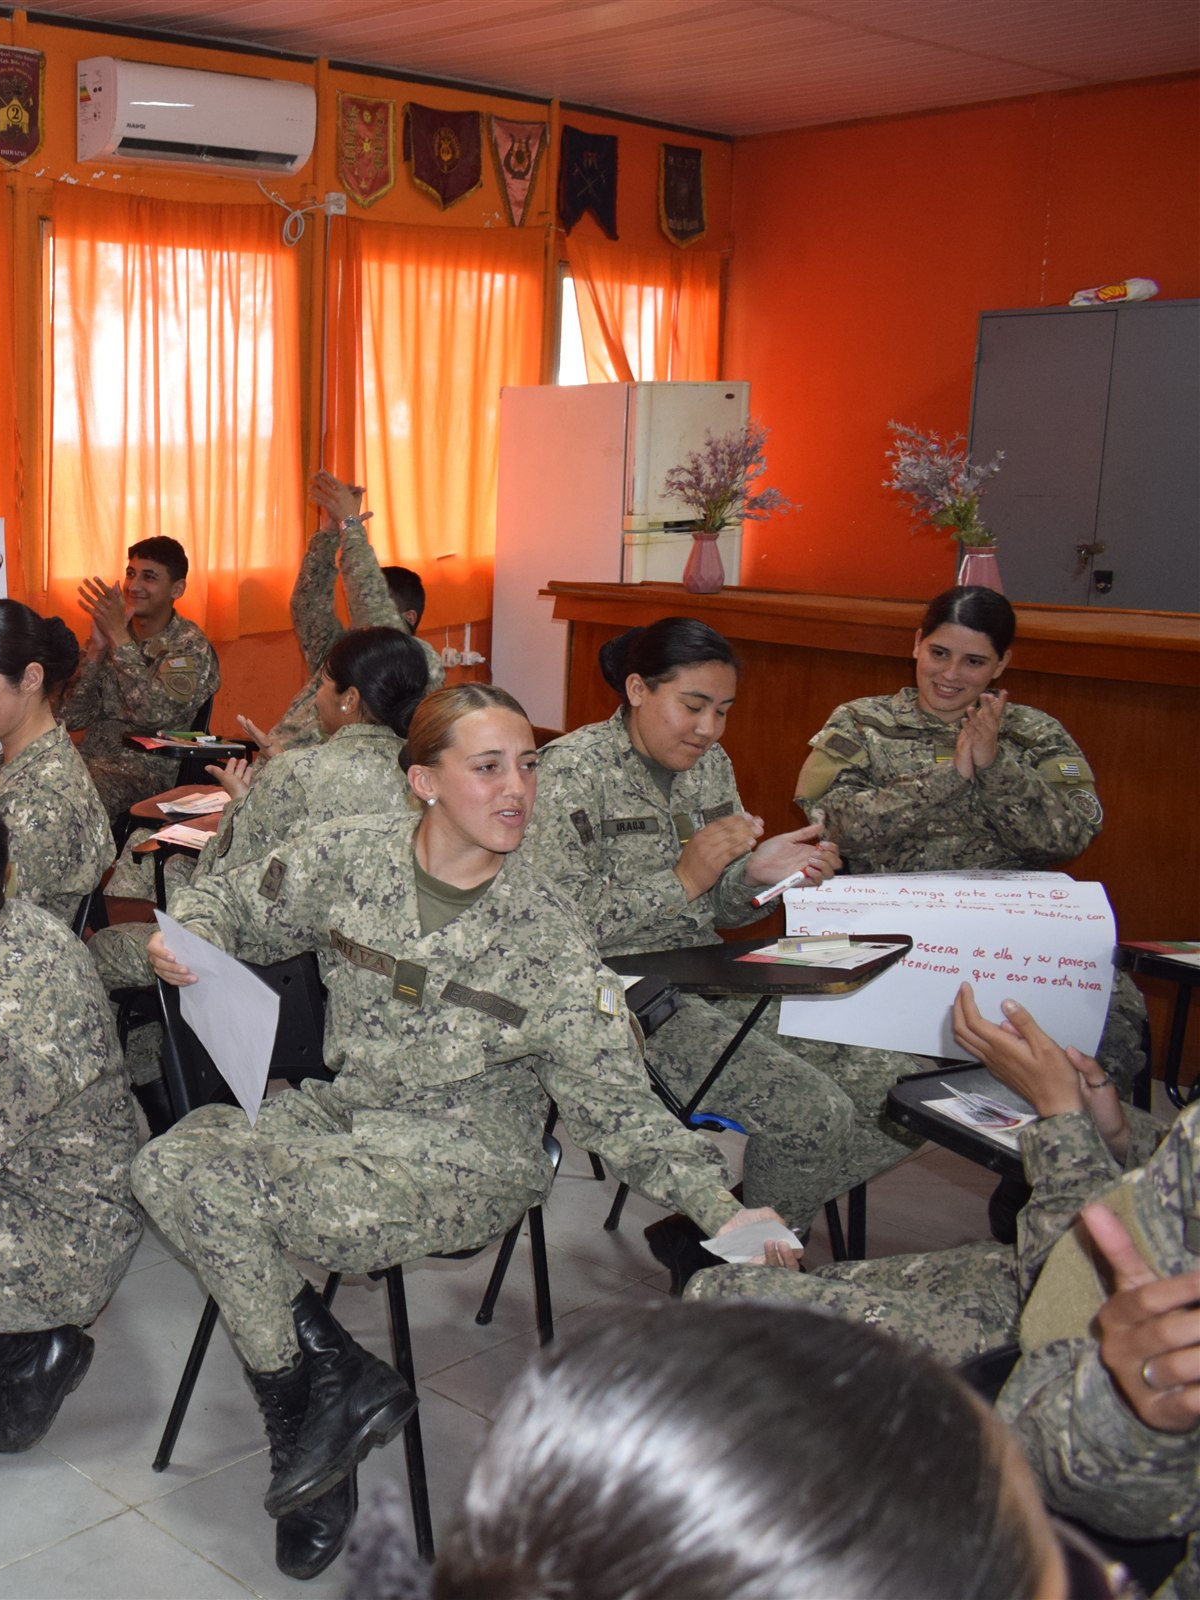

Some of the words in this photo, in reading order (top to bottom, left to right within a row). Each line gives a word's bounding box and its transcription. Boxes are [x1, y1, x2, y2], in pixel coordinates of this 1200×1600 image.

[11, 107, 20, 120] 2
[898, 887, 945, 899] Amiga
[954, 889, 987, 898] date
[972, 946, 986, 958] de
[993, 947, 1013, 961] ella
[1022, 955, 1032, 967] y
[1037, 953, 1052, 964] su
[1057, 956, 1097, 971] pareja
[895, 956, 960, 975] tendiendo
[971, 968, 996, 983] que
[1006, 972, 1029, 983] eso
[1032, 974, 1047, 985] no
[1077, 978, 1103, 992] bien
